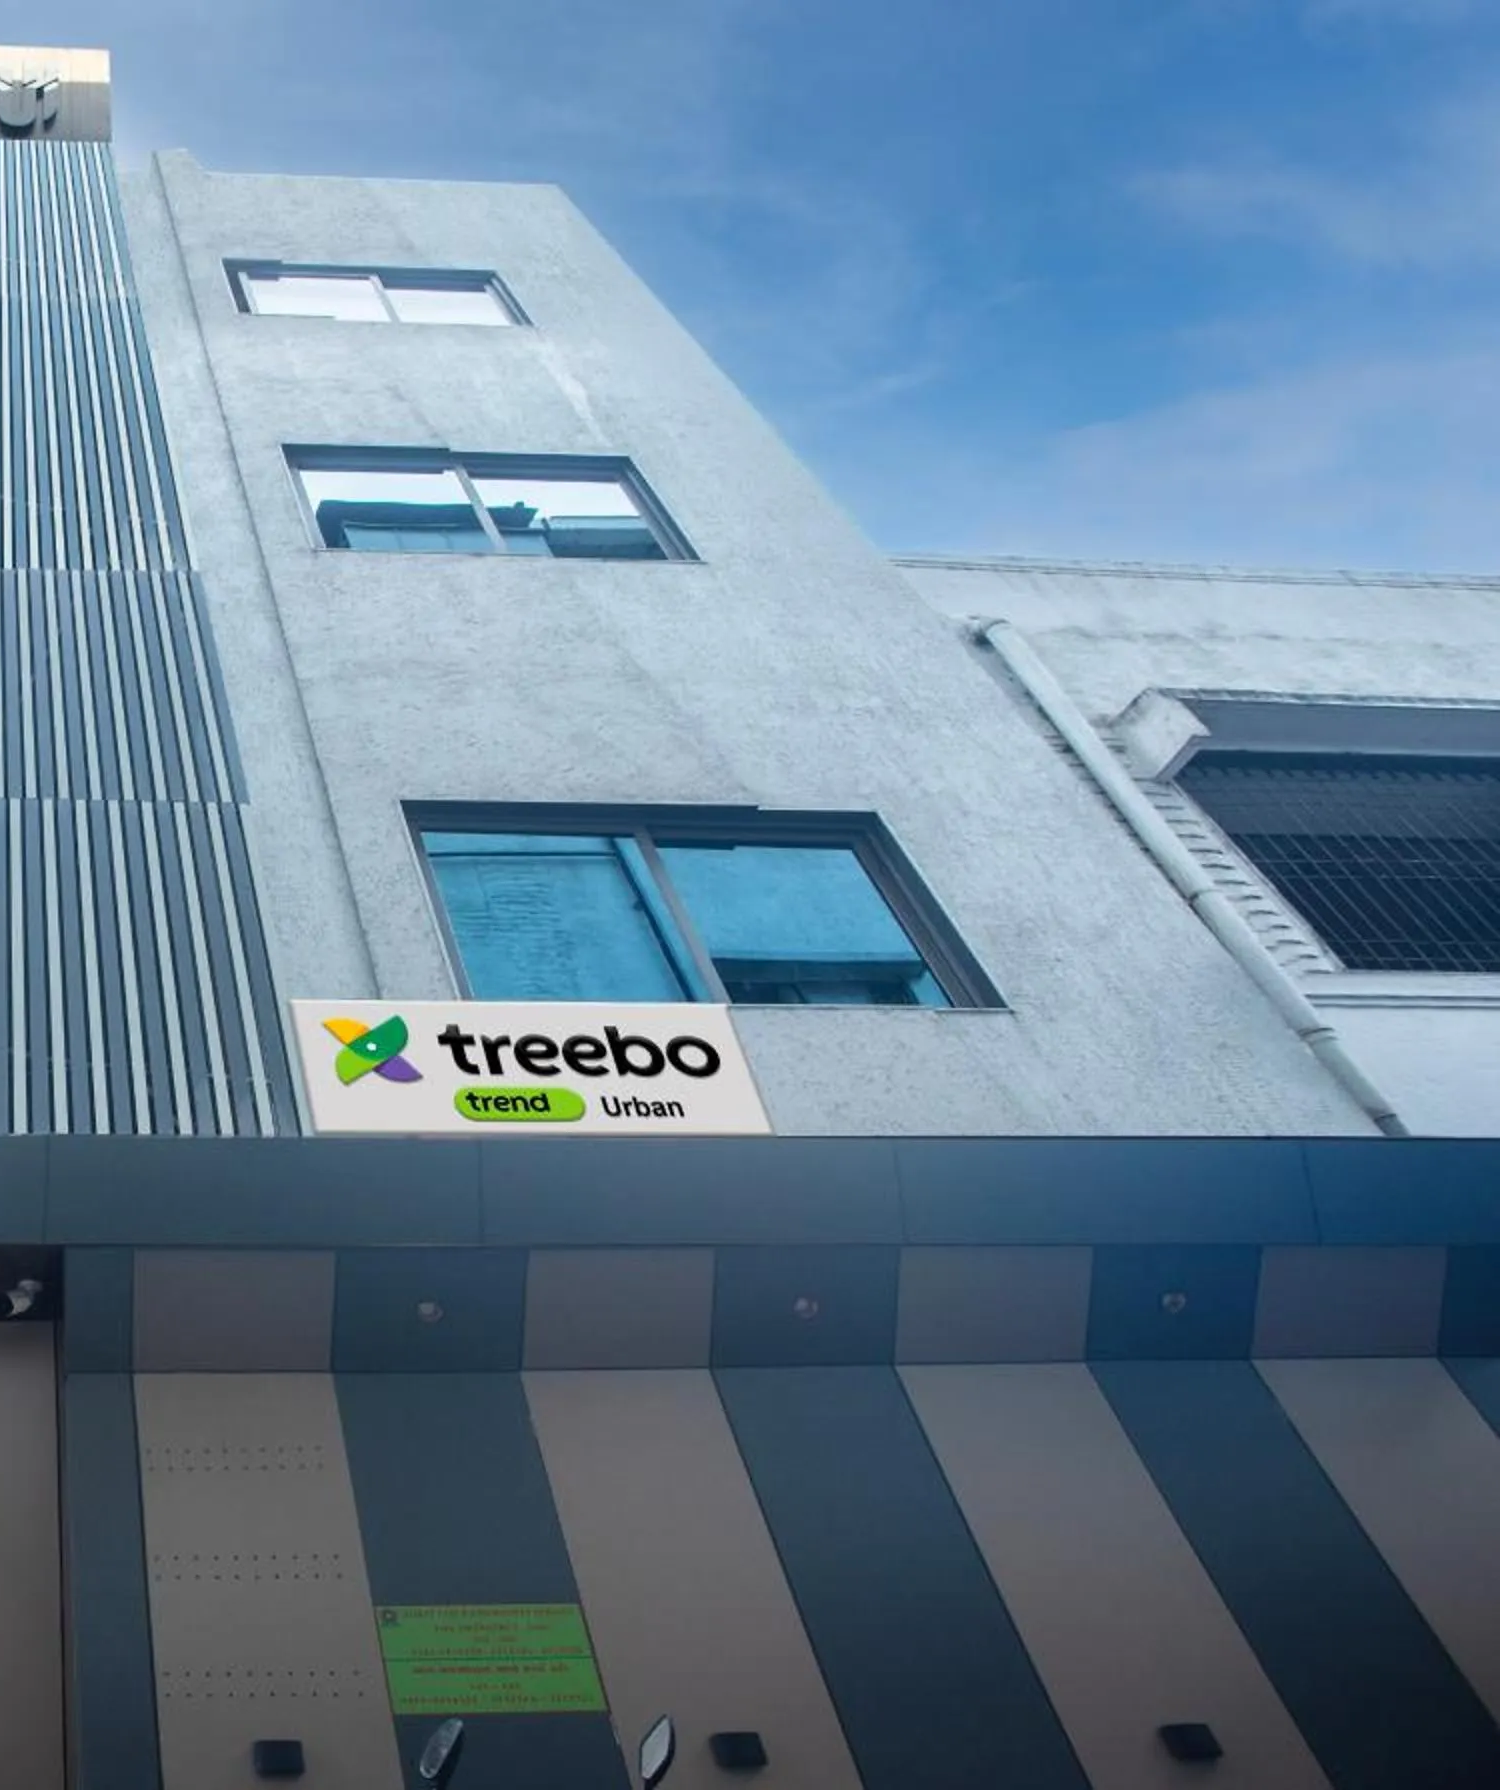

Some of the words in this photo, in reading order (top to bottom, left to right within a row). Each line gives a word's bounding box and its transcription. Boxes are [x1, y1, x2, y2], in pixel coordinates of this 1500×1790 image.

[437, 1023, 721, 1078] treebo
[465, 1091, 551, 1114] trend
[601, 1095, 685, 1118] Urban
